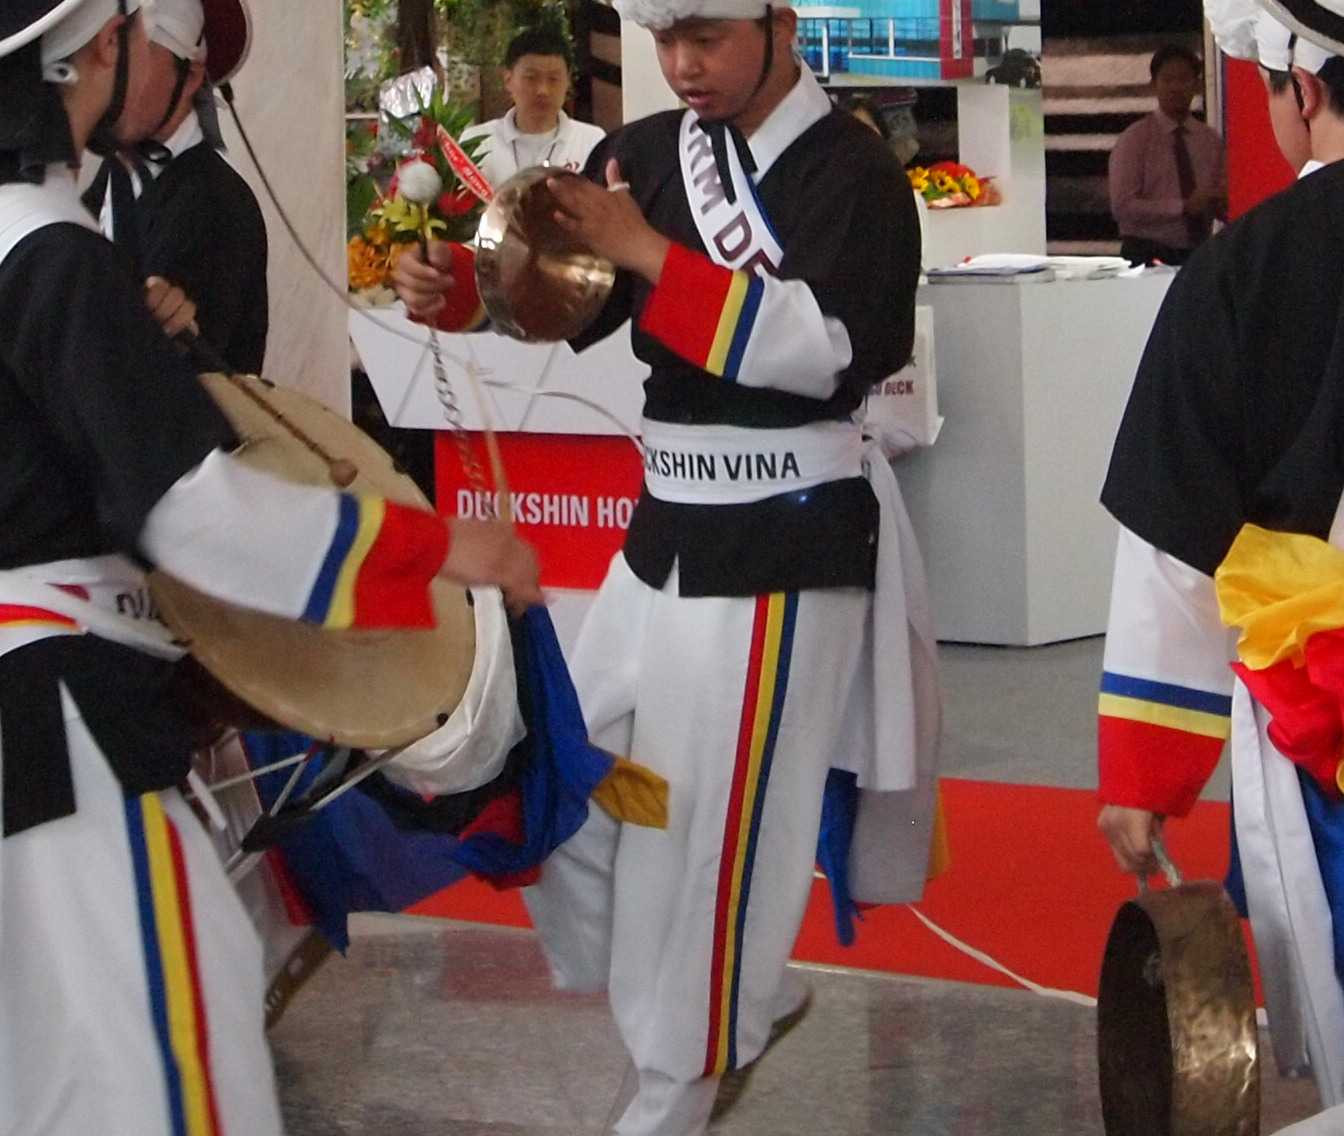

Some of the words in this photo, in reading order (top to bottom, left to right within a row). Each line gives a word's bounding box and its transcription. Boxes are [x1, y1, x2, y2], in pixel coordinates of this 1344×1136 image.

[686, 120, 728, 216] RM
[645, 446, 716, 481] KSHIN
[722, 451, 802, 480] VINA
